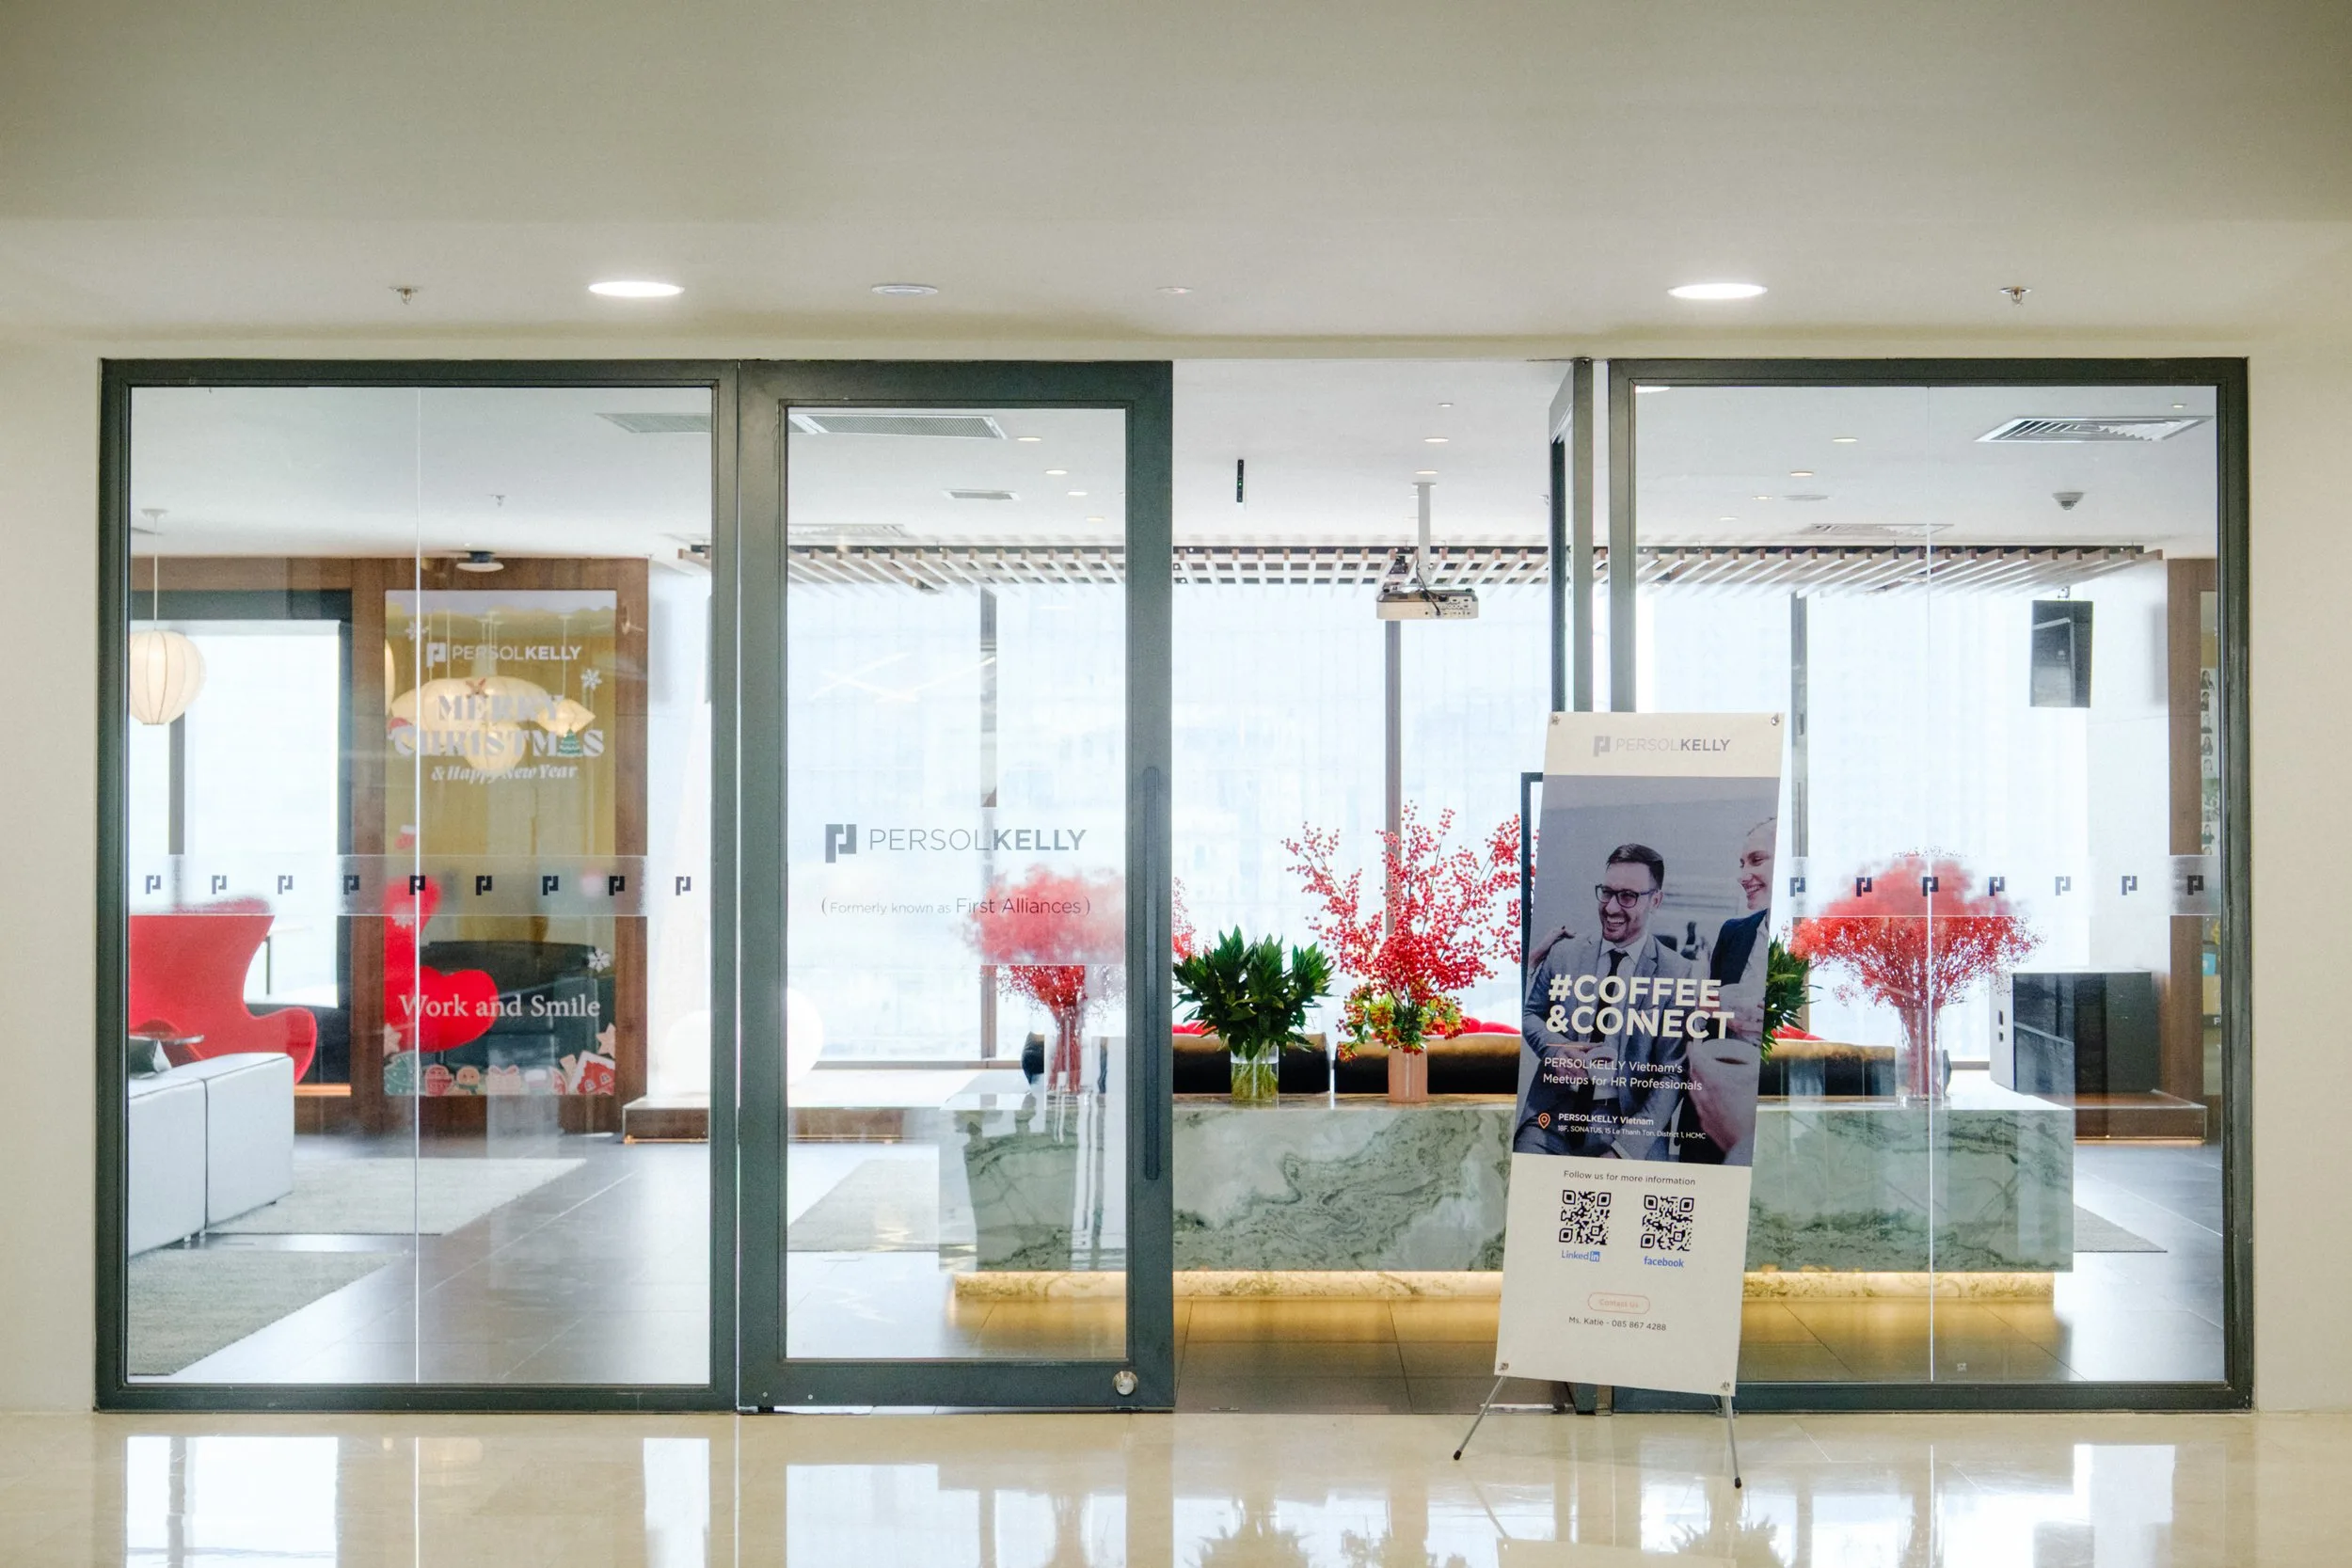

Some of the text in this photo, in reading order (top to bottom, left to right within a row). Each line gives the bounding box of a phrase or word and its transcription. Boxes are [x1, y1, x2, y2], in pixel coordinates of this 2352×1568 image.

[452, 645, 582, 660] PERSOLKELLY
[437, 695, 564, 721] MERRY
[1615, 737, 1730, 752] PERSOLKELLY
[447, 766, 498, 784] Happy
[501, 766, 538, 780] New
[539, 764, 579, 779] Year
[869, 829, 1086, 851] PERSOLKELLY
[891, 899, 933, 913] known
[937, 903, 952, 914] as
[956, 898, 995, 914] First
[1549, 974, 1722, 1007] #COFFEE
[399, 993, 601, 1017] Work and Smile
[1544, 1057, 1683, 1073] PERSOLKELLY Vietnam's
[1543, 1074, 1703, 1091] Meetups for HR Professionals
[1558, 1113, 1654, 1126] PERSOLKELLY Vietnam
[1564, 1170, 1593, 1180] Follow
[1606, 1173, 1619, 1181] for
[1645, 1175, 1696, 1186] information
[1644, 1256, 1685, 1268] facebook
[1568, 1316, 1581, 1324] Ms.
[1583, 1318, 1604, 1326] Katie
